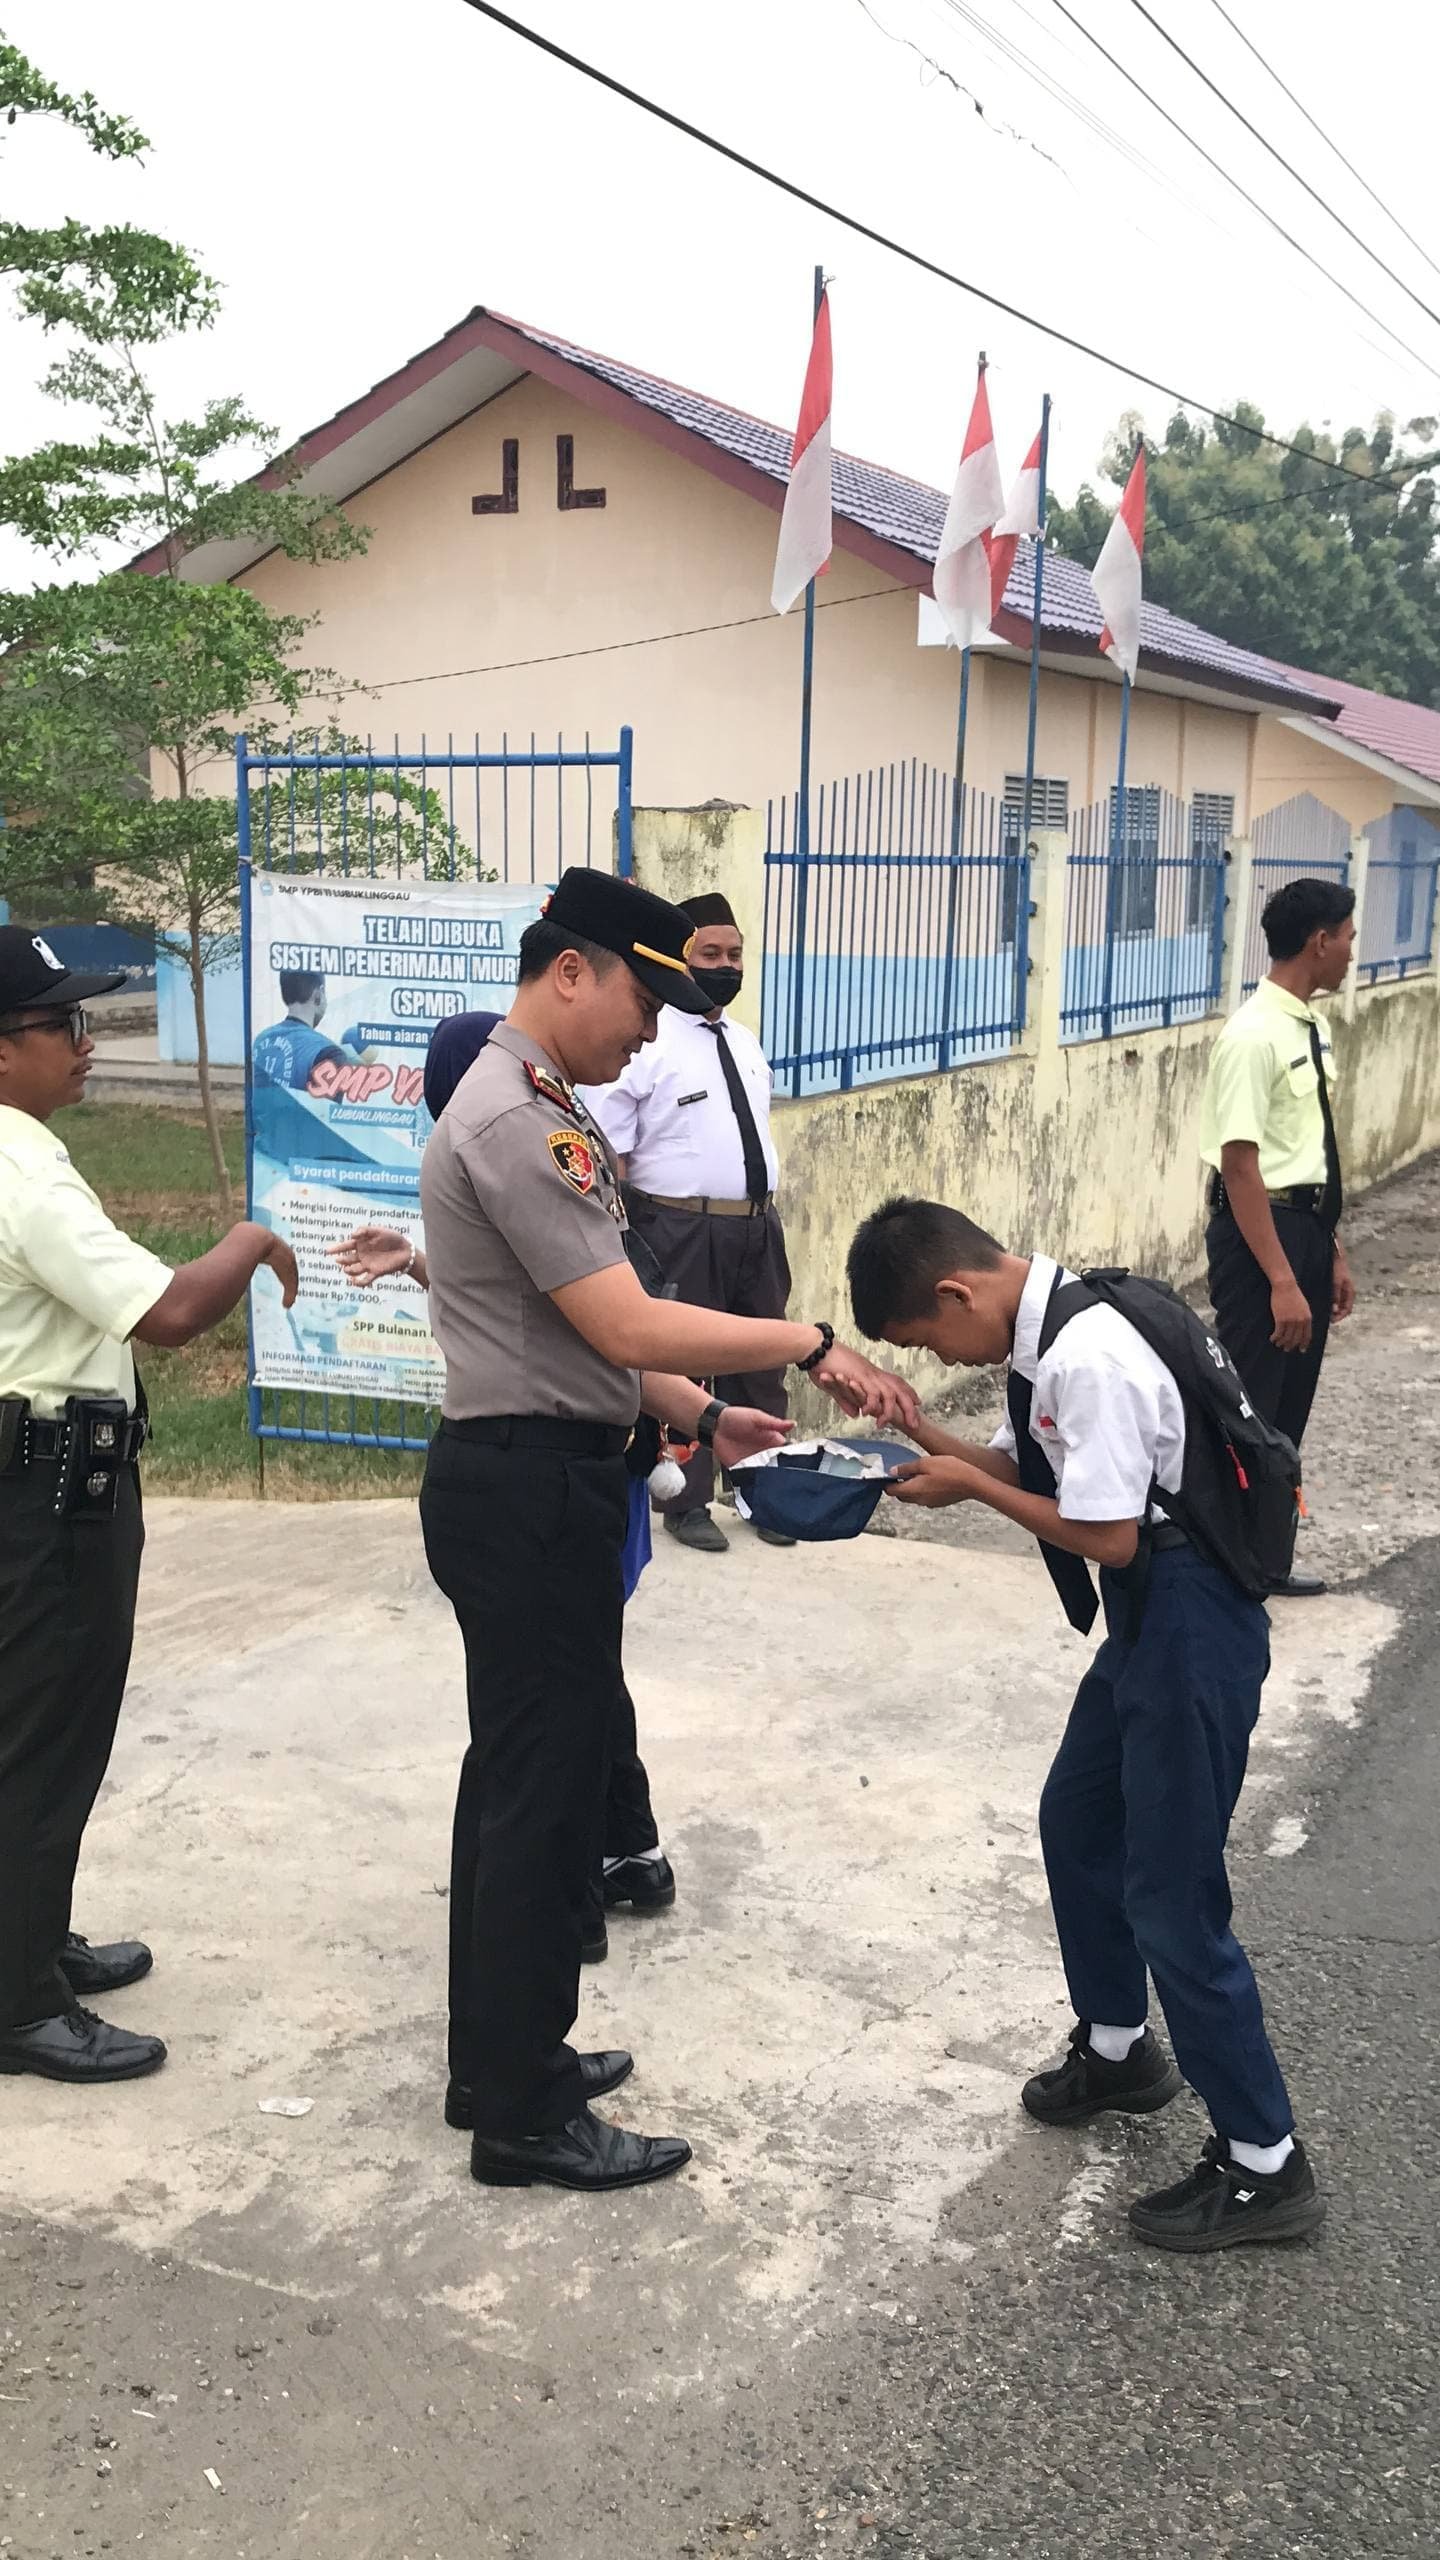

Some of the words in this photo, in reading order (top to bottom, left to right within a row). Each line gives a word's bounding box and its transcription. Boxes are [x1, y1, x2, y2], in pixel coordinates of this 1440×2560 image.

[278, 884, 297, 895] SMP
[332, 889, 411, 901] LUBUKLINGGAU
[364, 916, 425, 944] TELAH
[430, 919, 502, 948] DIBUKA
[271, 943, 340, 974] SISTEM
[343, 948, 467, 981] PENERIMAAN
[471, 955, 521, 984] MURI
[392, 989, 465, 1018] (SPMB)
[360, 1026, 392, 1042] Tahun
[394, 1028, 429, 1044] ajaran
[307, 1057, 394, 1104] SMP
[331, 1107, 416, 1126] LUBUKLINGGAU
[293, 1164, 336, 1179] Syarat
[289, 1200, 327, 1213] Mengisi
[328, 1203, 367, 1215] formulir
[369, 1207, 424, 1220] pendaftar
[290, 1215, 353, 1229] Melampirkan
[290, 1230, 336, 1243] sebanyak
[308, 1260, 343, 1273] sebany
[299, 1274, 342, 1288] embayar
[299, 1288, 328, 1300] besar
[353, 1320, 375, 1332] SPP
[378, 1322, 427, 1338] Bulanan
[262, 1351, 315, 1364] INFORMASI
[317, 1355, 387, 1371] PENDAFTARAN
